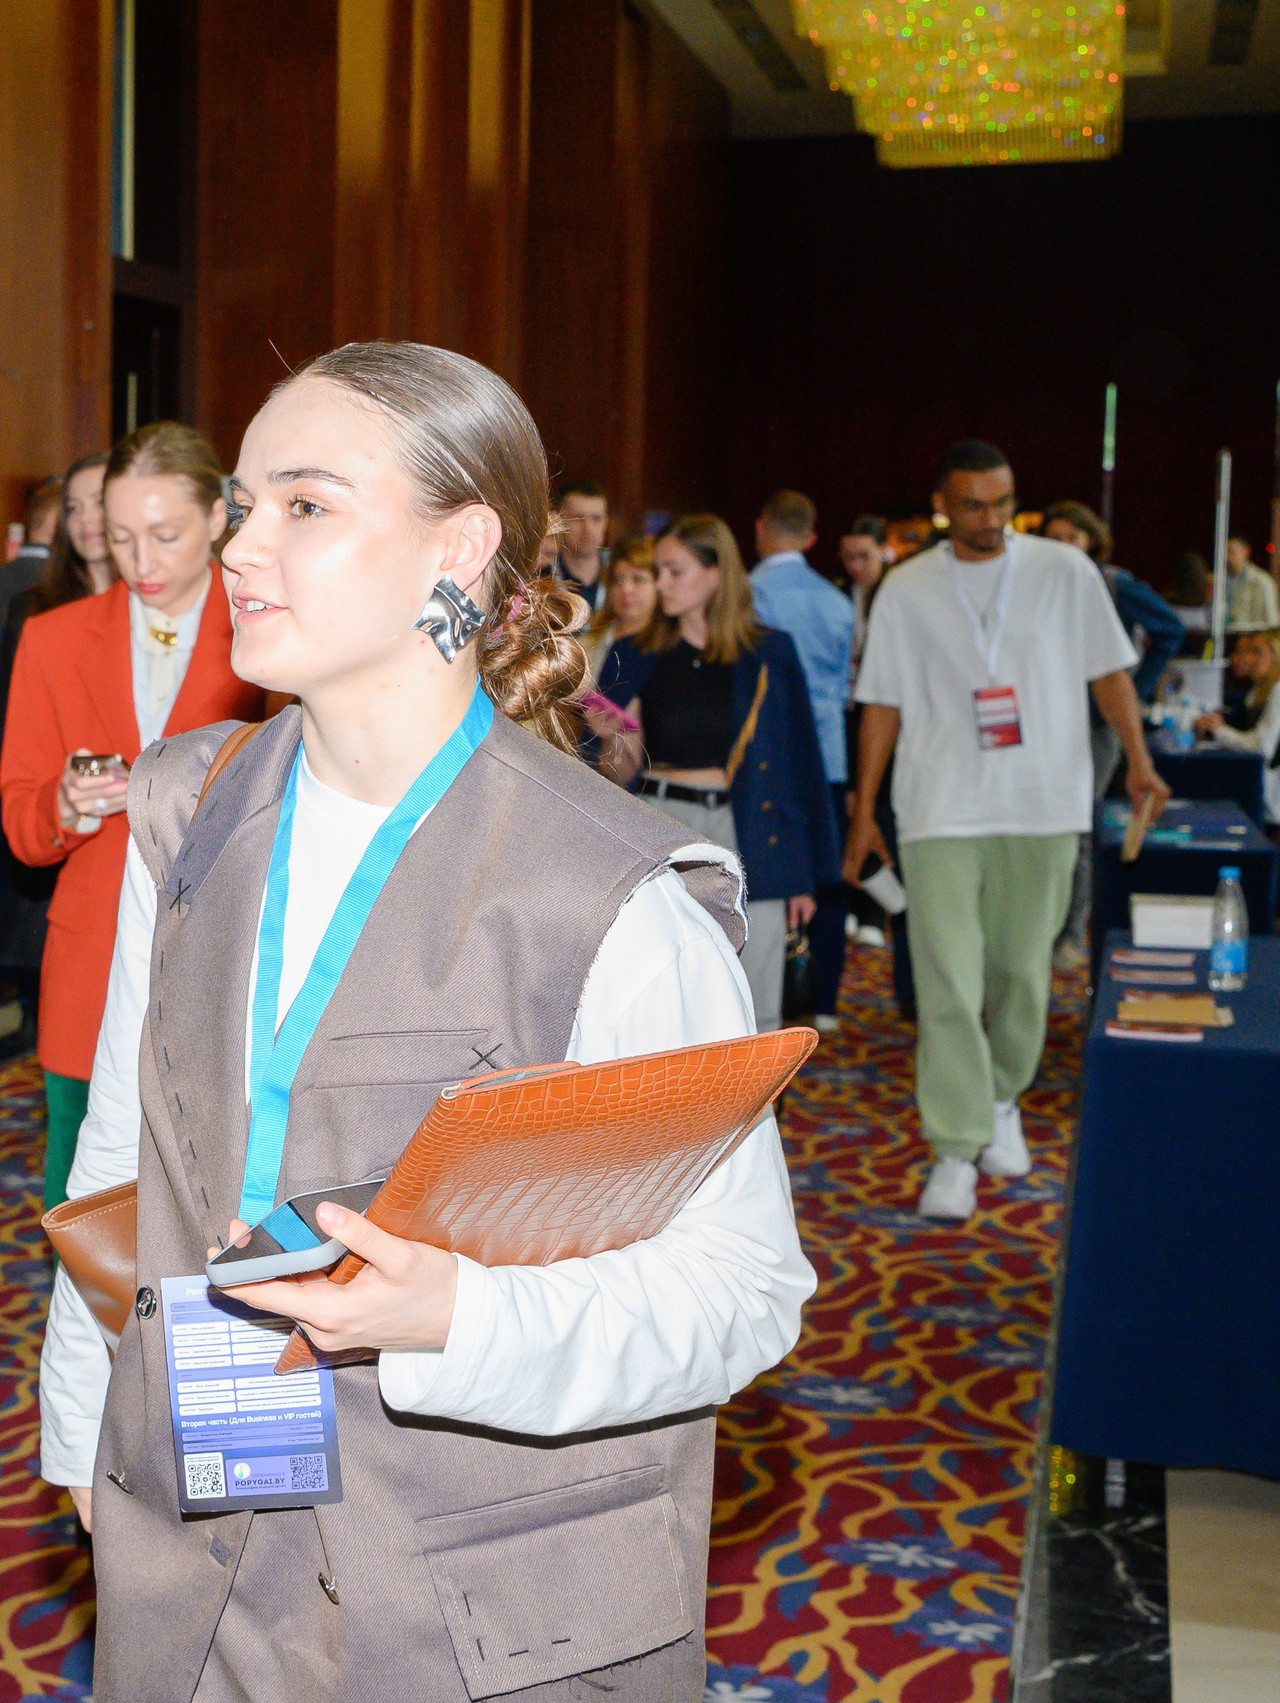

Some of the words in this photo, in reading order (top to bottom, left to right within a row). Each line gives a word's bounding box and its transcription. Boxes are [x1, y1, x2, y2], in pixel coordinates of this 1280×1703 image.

[181, 1420, 207, 1429] Вторая
[229, 1416, 246, 1425] (Для
[246, 1415, 277, 1423] Business
[283, 1412, 295, 1420] VIP
[295, 1410, 322, 1419] гостей)
